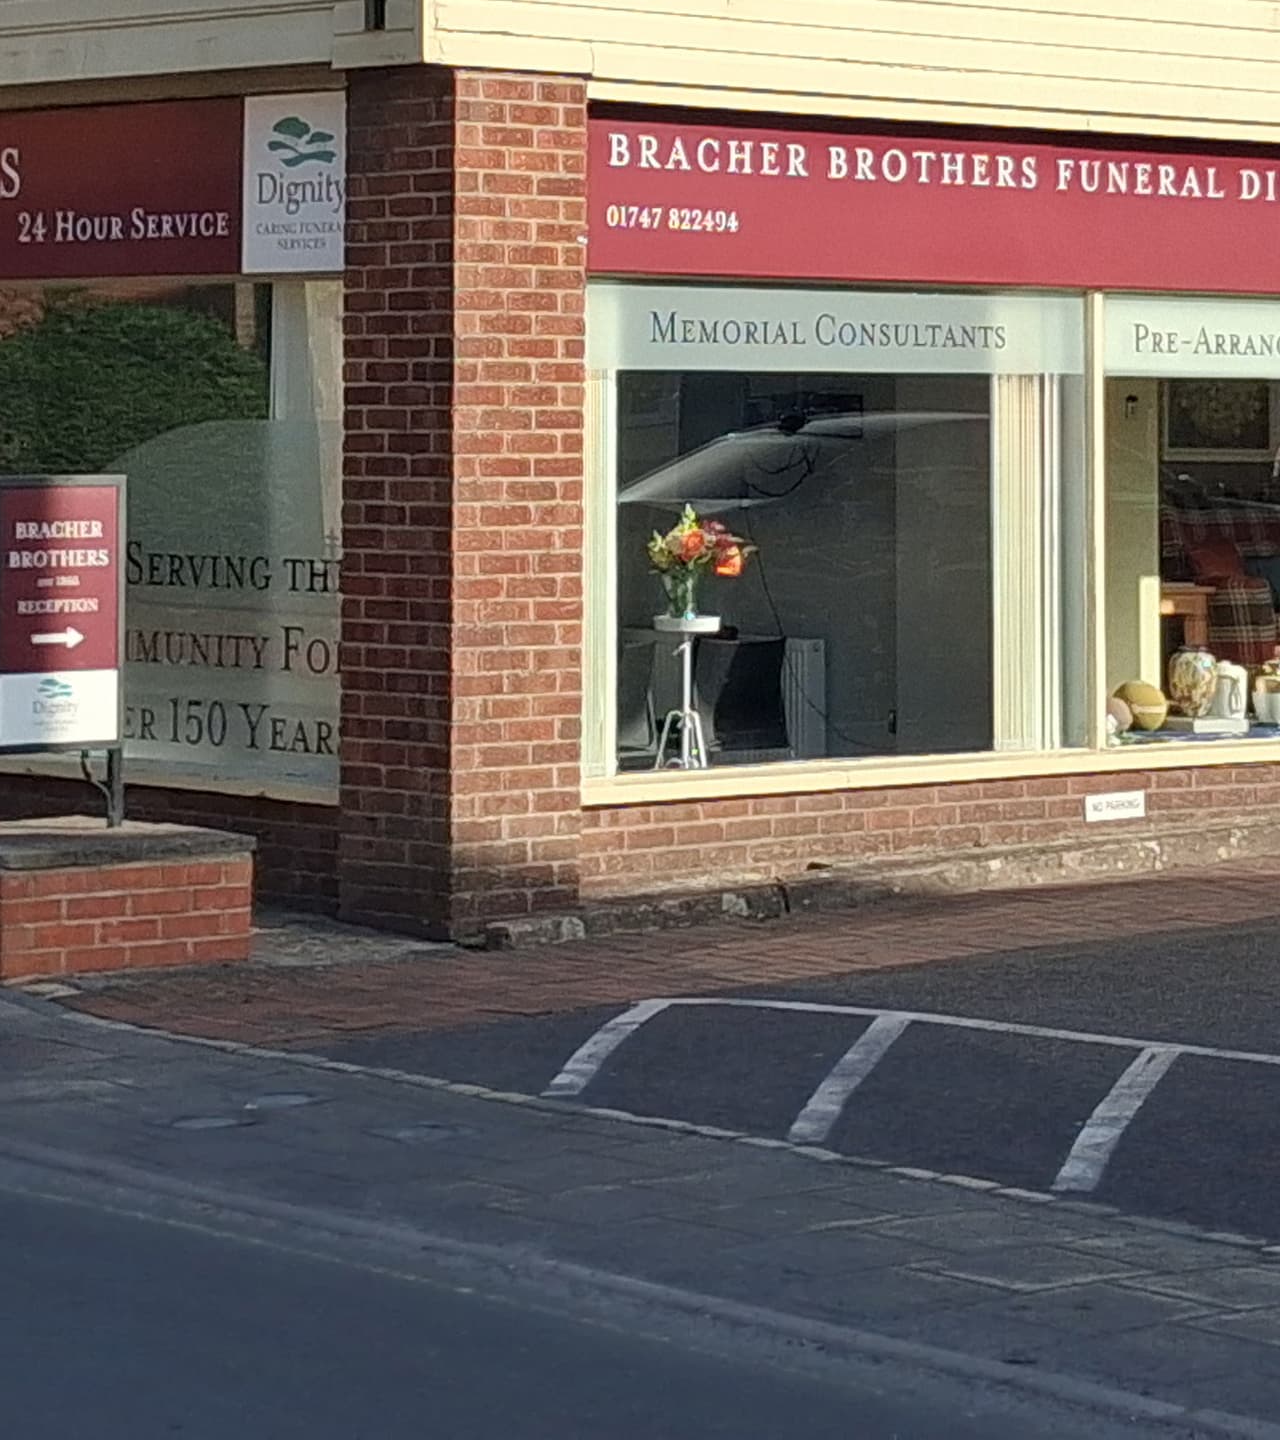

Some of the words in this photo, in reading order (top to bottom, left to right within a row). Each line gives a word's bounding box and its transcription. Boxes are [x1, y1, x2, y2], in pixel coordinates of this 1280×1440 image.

[607, 133, 809, 177] BRACHER
[827, 146, 1038, 189] BROTHERS
[1056, 158, 1225, 198] FUNERAL
[257, 171, 346, 215] Dignity
[18, 212, 47, 243] 24
[55, 210, 123, 242] HOUR
[131, 207, 230, 239] SERVICE
[300, 221, 344, 234] FUNERA
[606, 205, 662, 229] 01747
[668, 207, 739, 233] 822494
[649, 311, 806, 346] MEMORIAL
[815, 314, 1006, 349] CONSULTANTS
[16, 520, 103, 539] BRACHER
[9, 548, 109, 568] BROTHERS
[126, 541, 272, 590] SERVING
[17, 598, 98, 614] RECEPTION
[125, 629, 271, 669] MUNITY
[123, 707, 158, 741] ER
[170, 698, 227, 747] 150
[238, 703, 341, 755] YEAR
